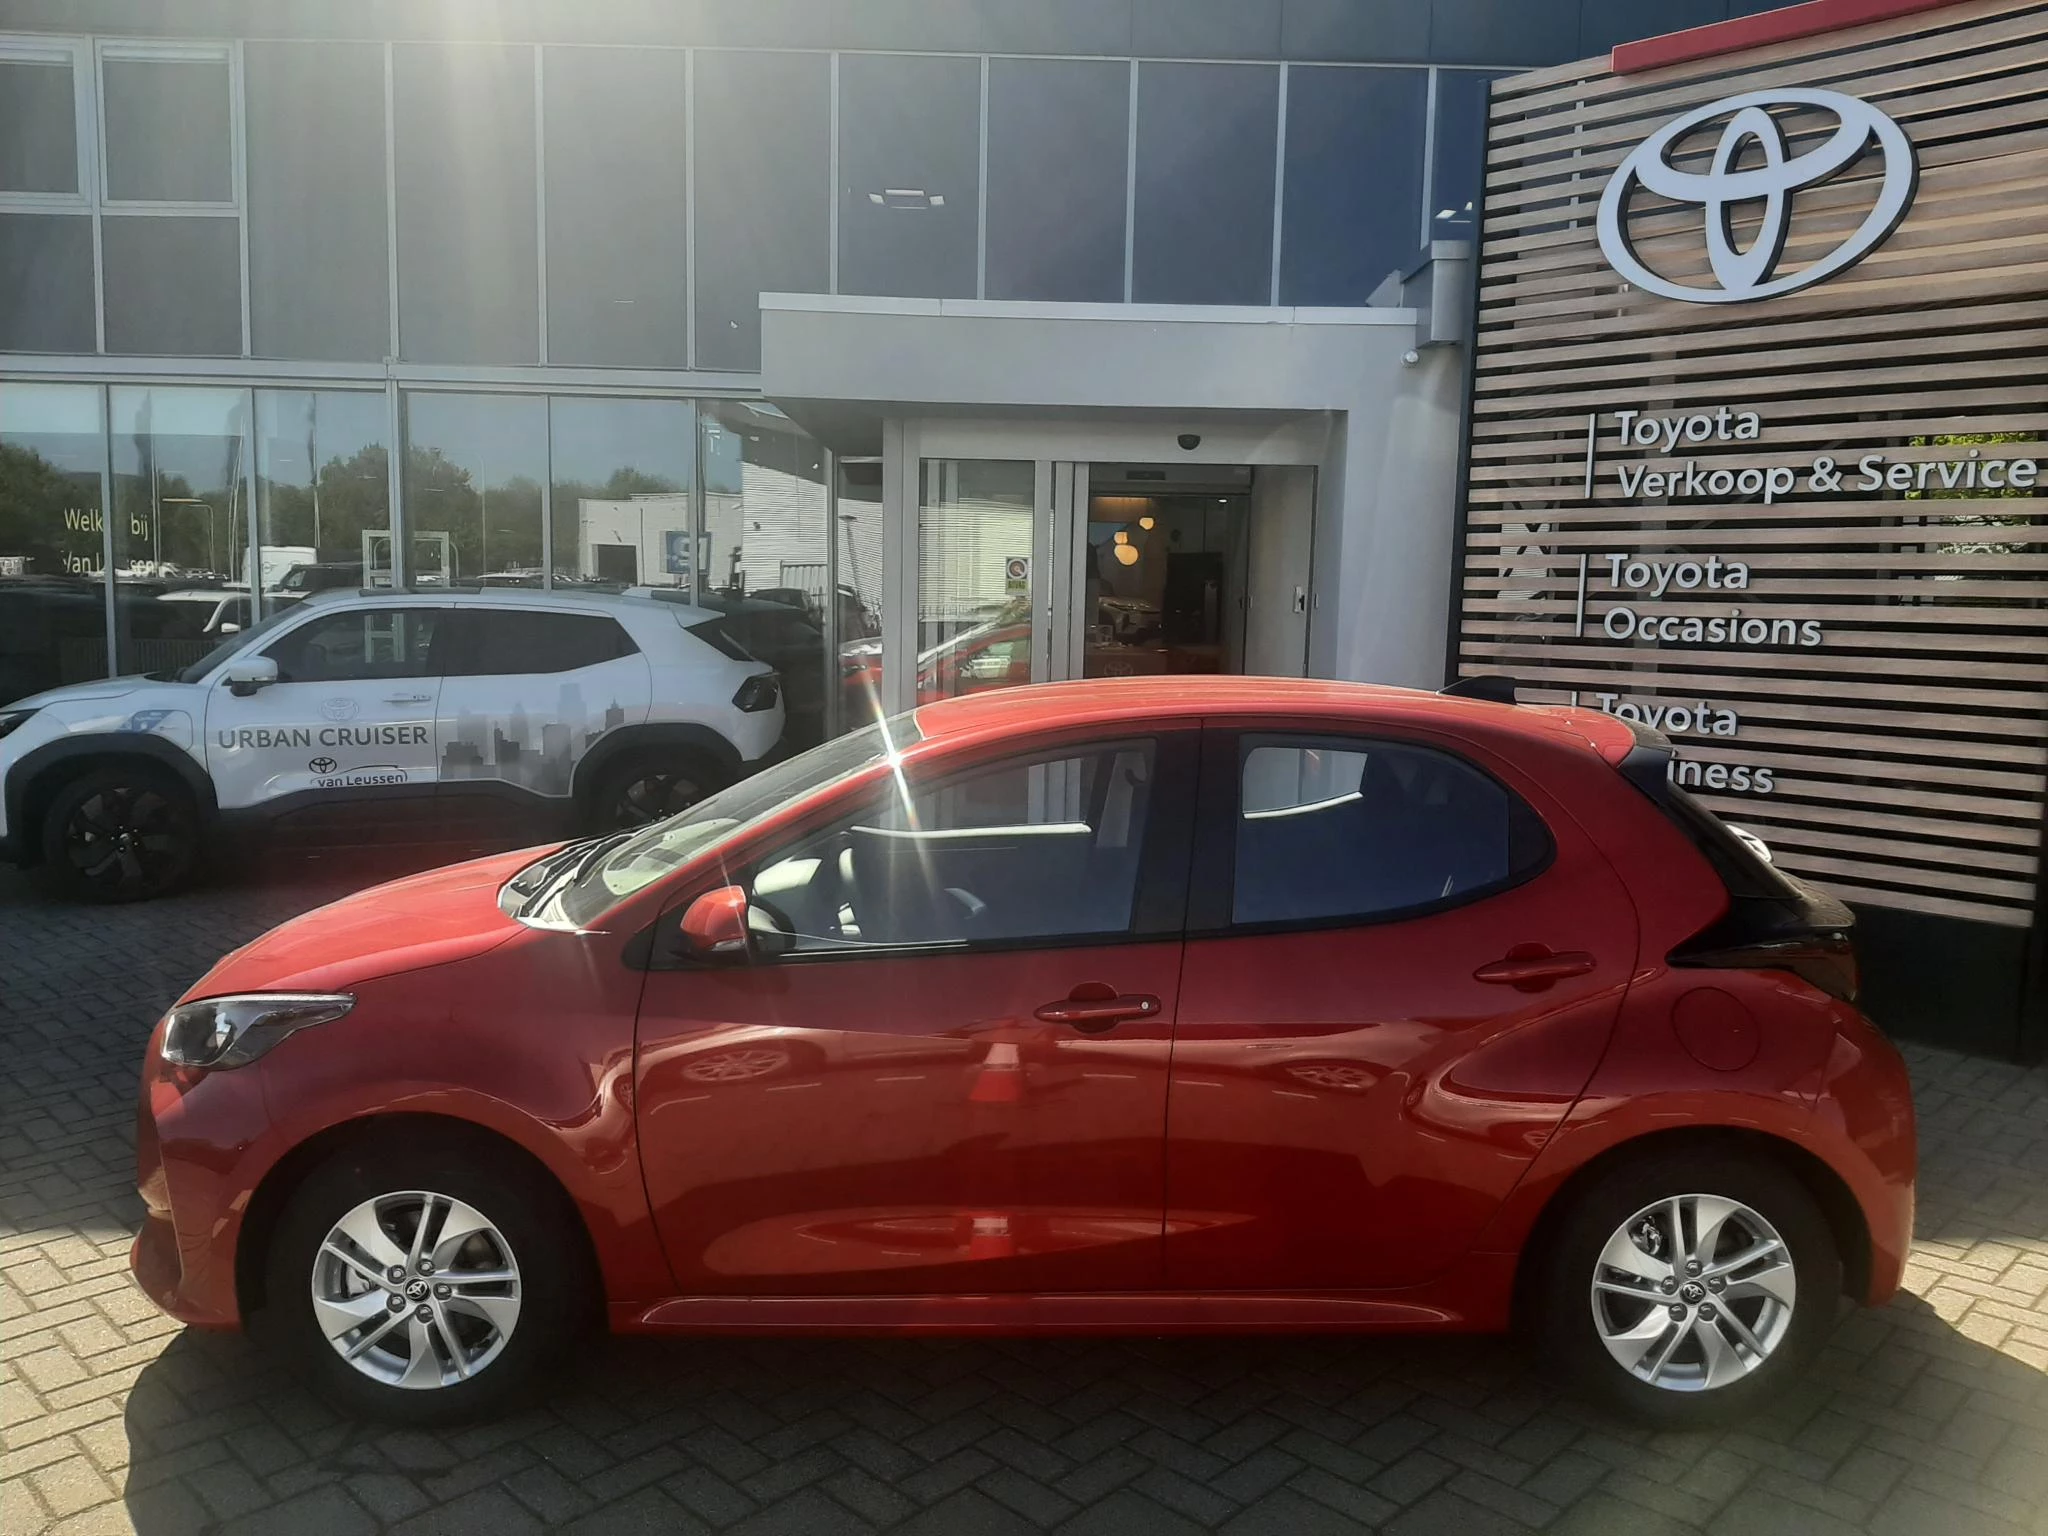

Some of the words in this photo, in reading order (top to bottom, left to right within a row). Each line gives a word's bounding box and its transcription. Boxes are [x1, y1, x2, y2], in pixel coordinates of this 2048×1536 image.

[1614, 406, 1761, 453] Toyota
[1617, 460, 1795, 504] Verkoop
[1808, 456, 1842, 492] &
[1857, 449, 2038, 491] Service
[64, 507, 104, 532] Welk
[131, 511, 148, 541] bij
[1605, 553, 1749, 597] Toyota
[1604, 607, 1822, 646] Occasions
[218, 728, 311, 749] URBAN
[319, 726, 429, 746] CRUISER
[317, 778, 343, 787] van
[346, 774, 403, 786] Leussen
[1667, 749, 1774, 794] iness
